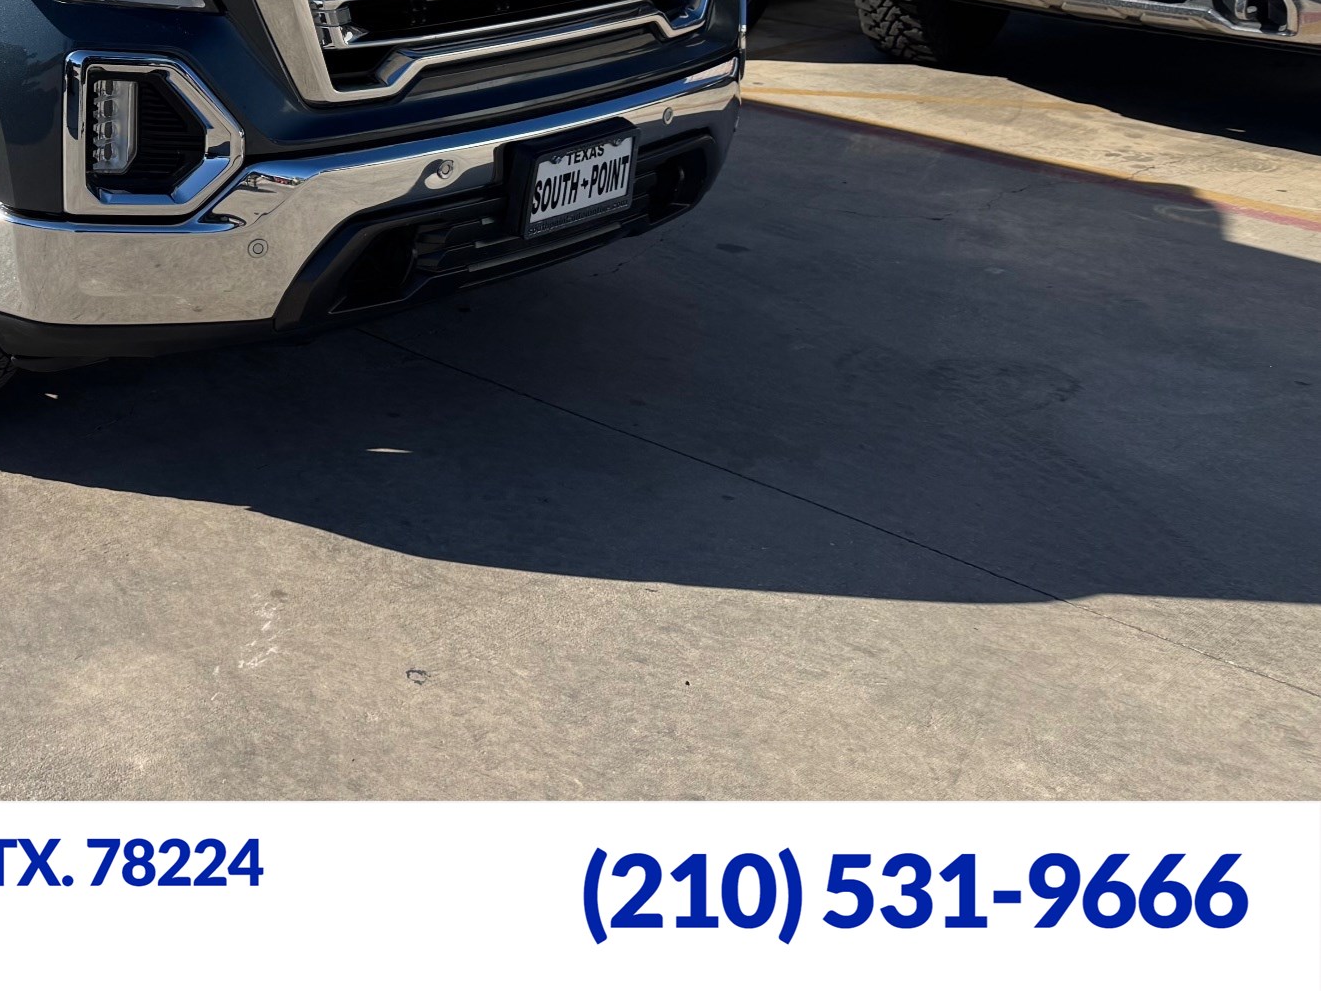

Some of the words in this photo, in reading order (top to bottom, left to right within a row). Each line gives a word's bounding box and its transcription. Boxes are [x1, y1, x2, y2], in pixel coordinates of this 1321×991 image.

[566, 144, 605, 166] TEXAS
[531, 169, 581, 215] SOUTH
[588, 155, 630, 199] POINT
